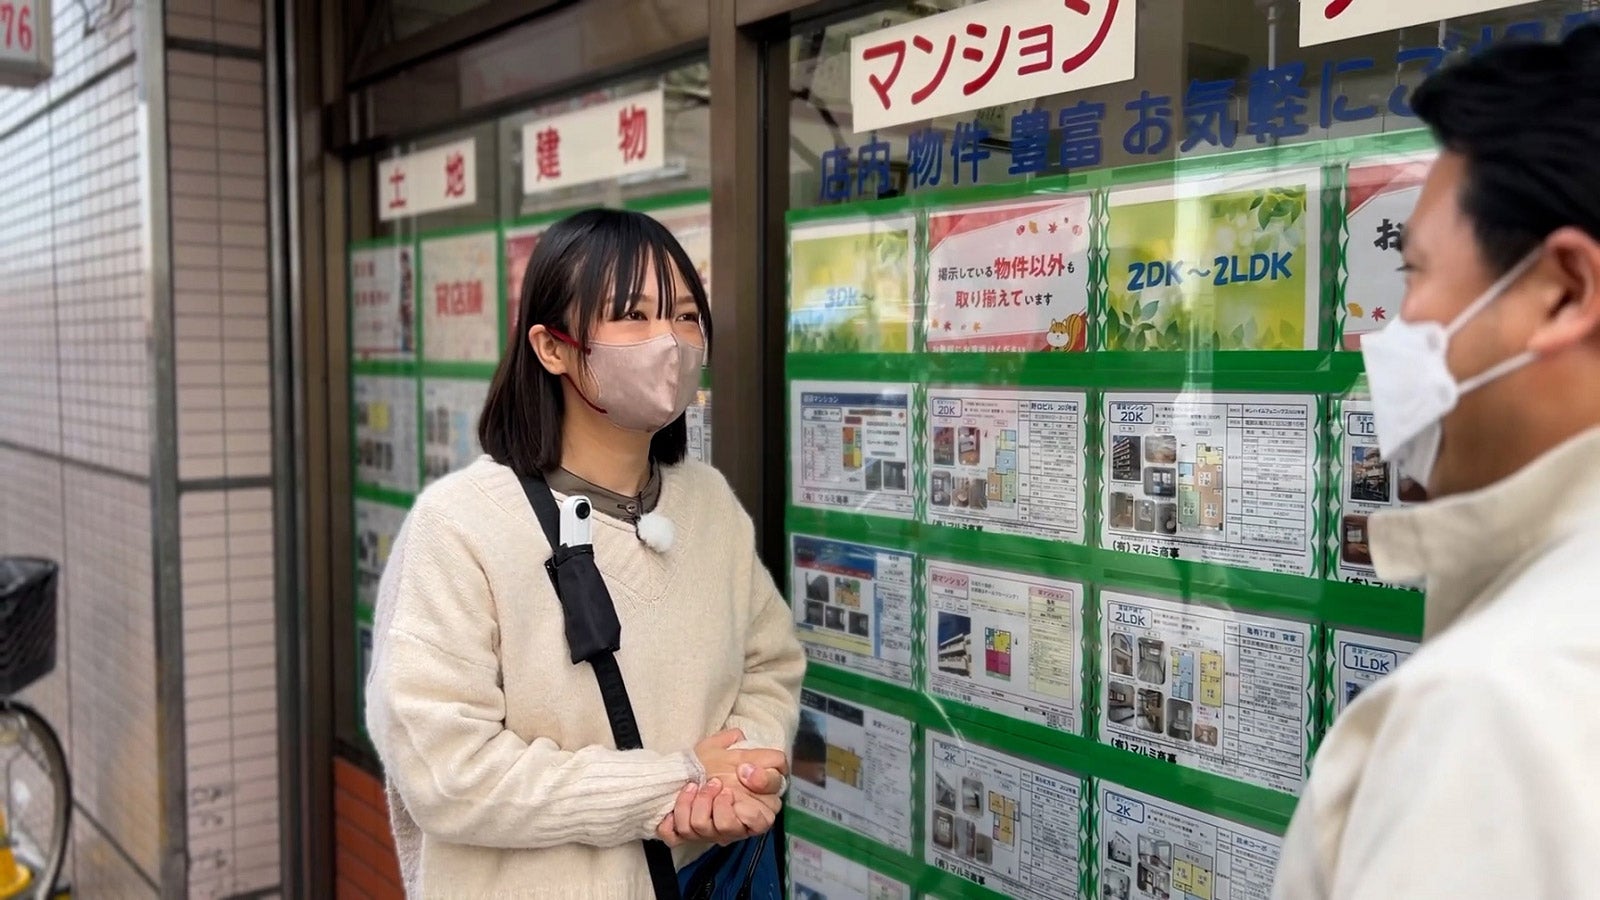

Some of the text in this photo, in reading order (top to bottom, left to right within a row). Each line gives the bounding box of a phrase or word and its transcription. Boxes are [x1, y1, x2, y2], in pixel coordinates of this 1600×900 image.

[863, 0, 1118, 110] マンション
[1373, 218, 1403, 251] お
[938, 253, 1075, 281] 掲示している物件以外も
[955, 288, 1053, 309] 取り揃えています
[938, 406, 956, 415] 2DK
[1120, 411, 1144, 422] 2DK
[1359, 421, 1375, 434] 1D
[1115, 611, 1146, 627] 2LDK
[1353, 655, 1390, 672] 1LDK
[944, 751, 956, 763] 2K
[1116, 803, 1131, 817] 2K
